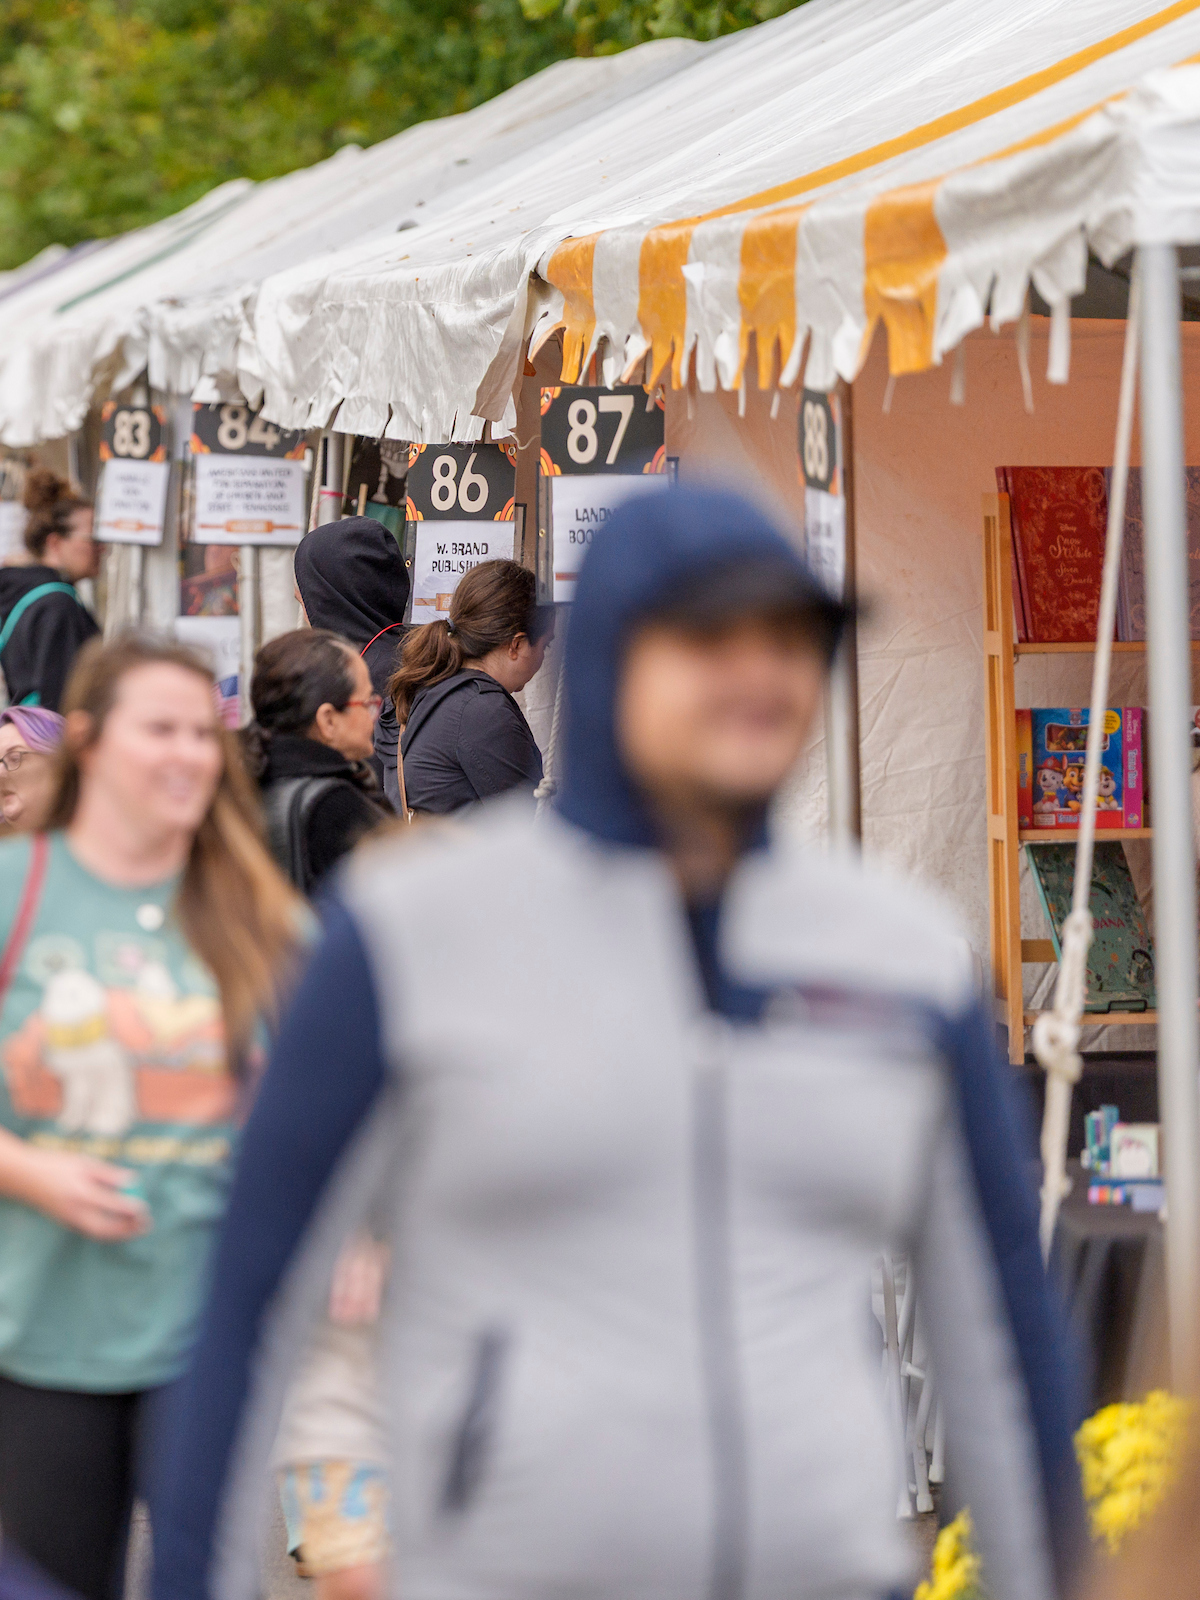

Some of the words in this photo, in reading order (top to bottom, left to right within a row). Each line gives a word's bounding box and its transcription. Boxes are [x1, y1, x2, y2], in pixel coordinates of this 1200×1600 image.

[113, 410, 151, 458] 83
[217, 404, 281, 451] 84
[567, 394, 634, 465] 87
[804, 400, 828, 482] 88
[430, 452, 489, 513] 86
[575, 507, 615, 523] LAND
[436, 543, 448, 555] W.
[451, 542, 489, 556] BRAND
[568, 529, 598, 545] BOO
[1049, 534, 1081, 558] Snow
[1063, 544, 1092, 558] White
[1092, 916, 1126, 930] OANA
